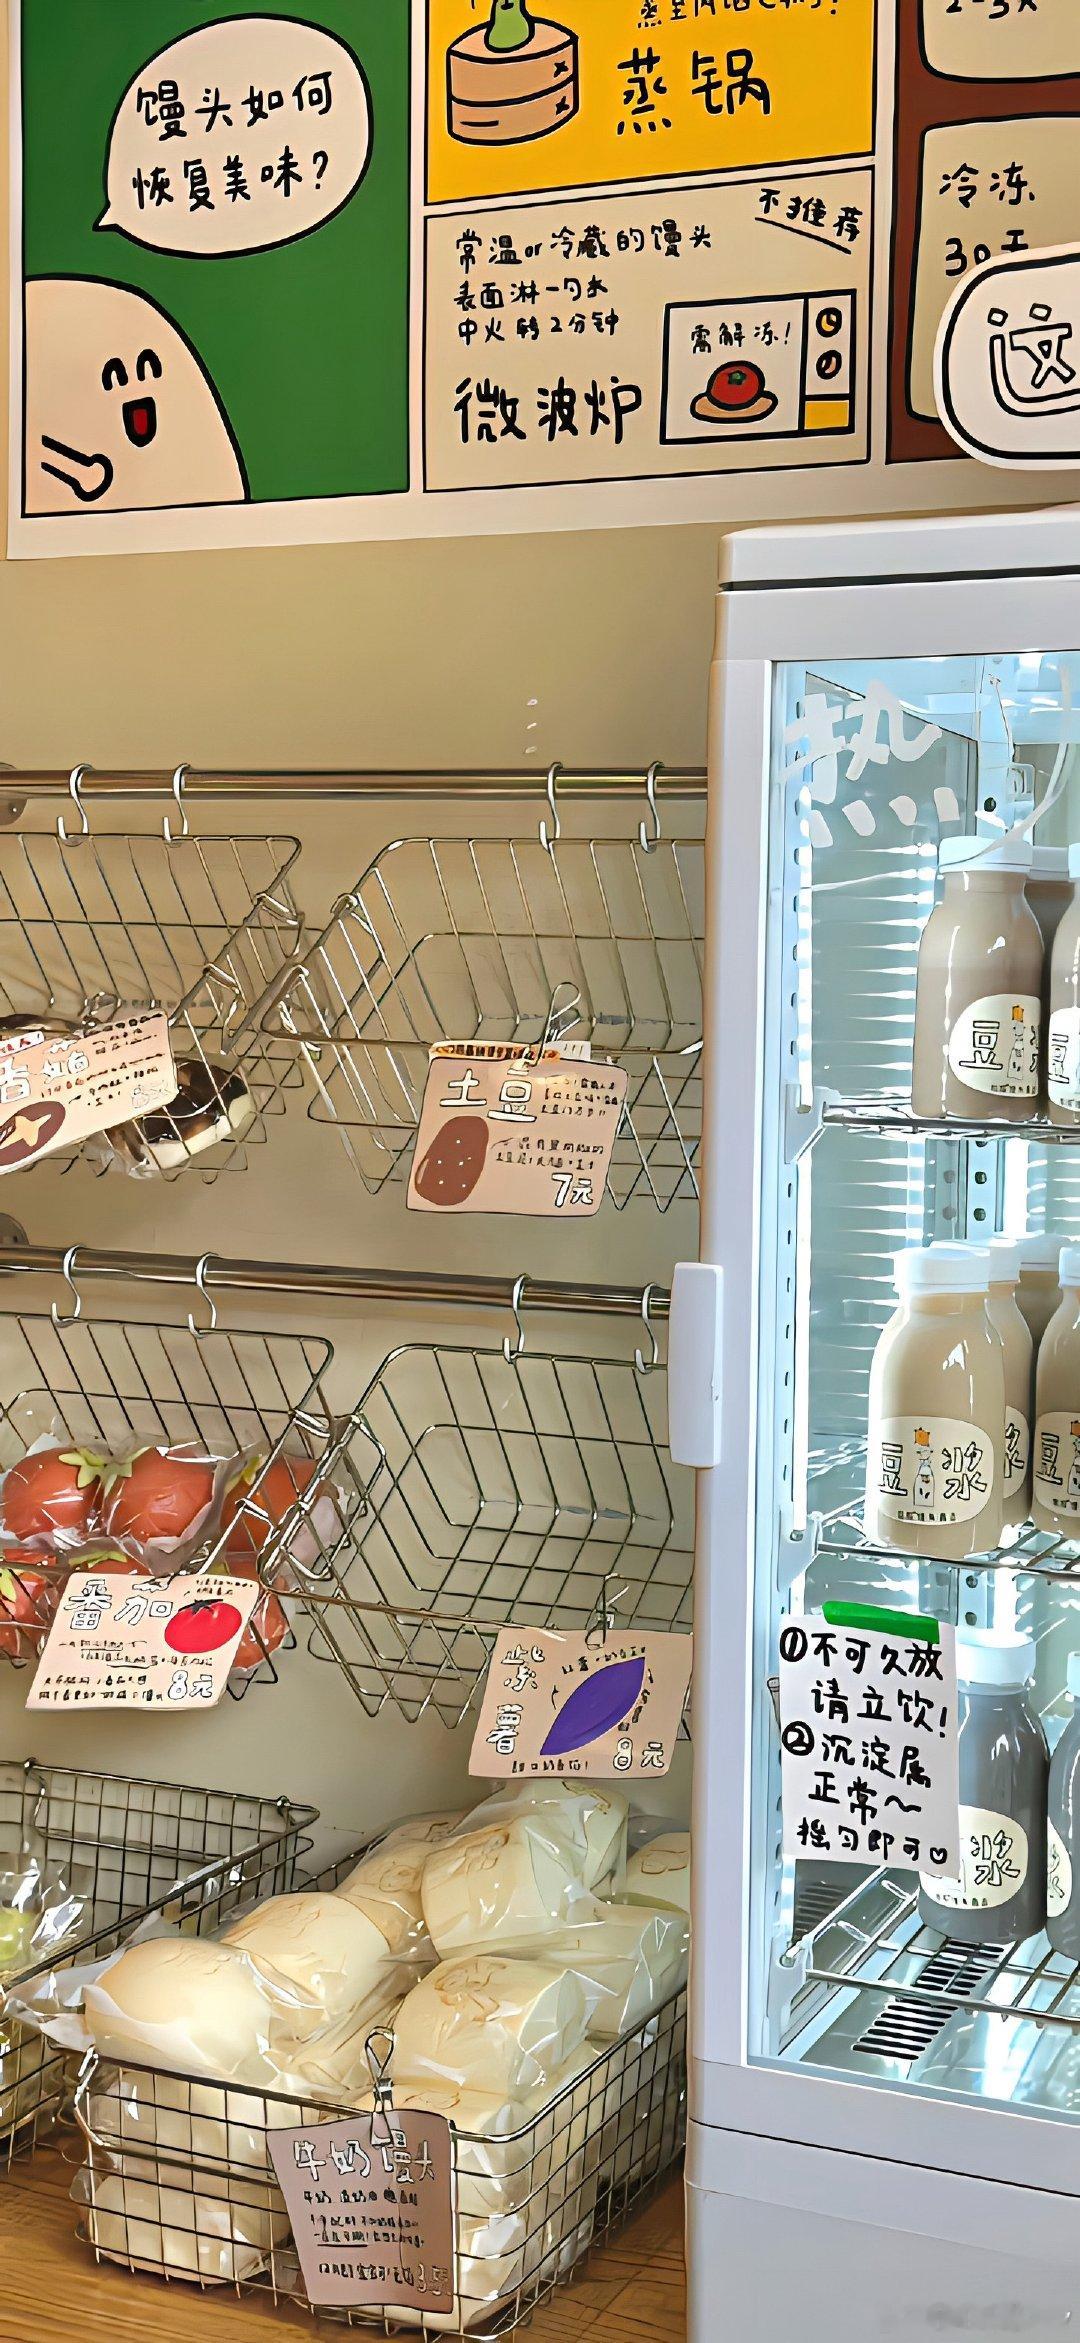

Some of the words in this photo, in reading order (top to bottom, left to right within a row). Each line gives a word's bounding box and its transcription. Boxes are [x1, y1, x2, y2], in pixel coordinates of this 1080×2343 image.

[136, 71, 332, 141] 馒头如何
[617, 48, 771, 135] 蒸锅
[132, 146, 329, 212] 恢复美味?
[939, 161, 1036, 208] 冷冻
[759, 188, 864, 242] 不推荐
[456, 219, 712, 274] 常温or冷藏的馒头
[454, 275, 608, 312] 表面淋一勺水
[458, 308, 620, 345] 中火转2分钟
[690, 321, 792, 354] 需解冻!
[454, 377, 643, 444] 微波炉
[779, 680, 960, 848] 热
[439, 1067, 537, 1122] 土豆
[552, 1173, 593, 1208] 7元
[63, 1578, 173, 1631] 番茄
[167, 1669, 213, 1700] 8元
[486, 1644, 545, 1755] 紫薯
[811, 1678, 948, 1738] 请立饮!
[613, 1737, 664, 1771] 8元
